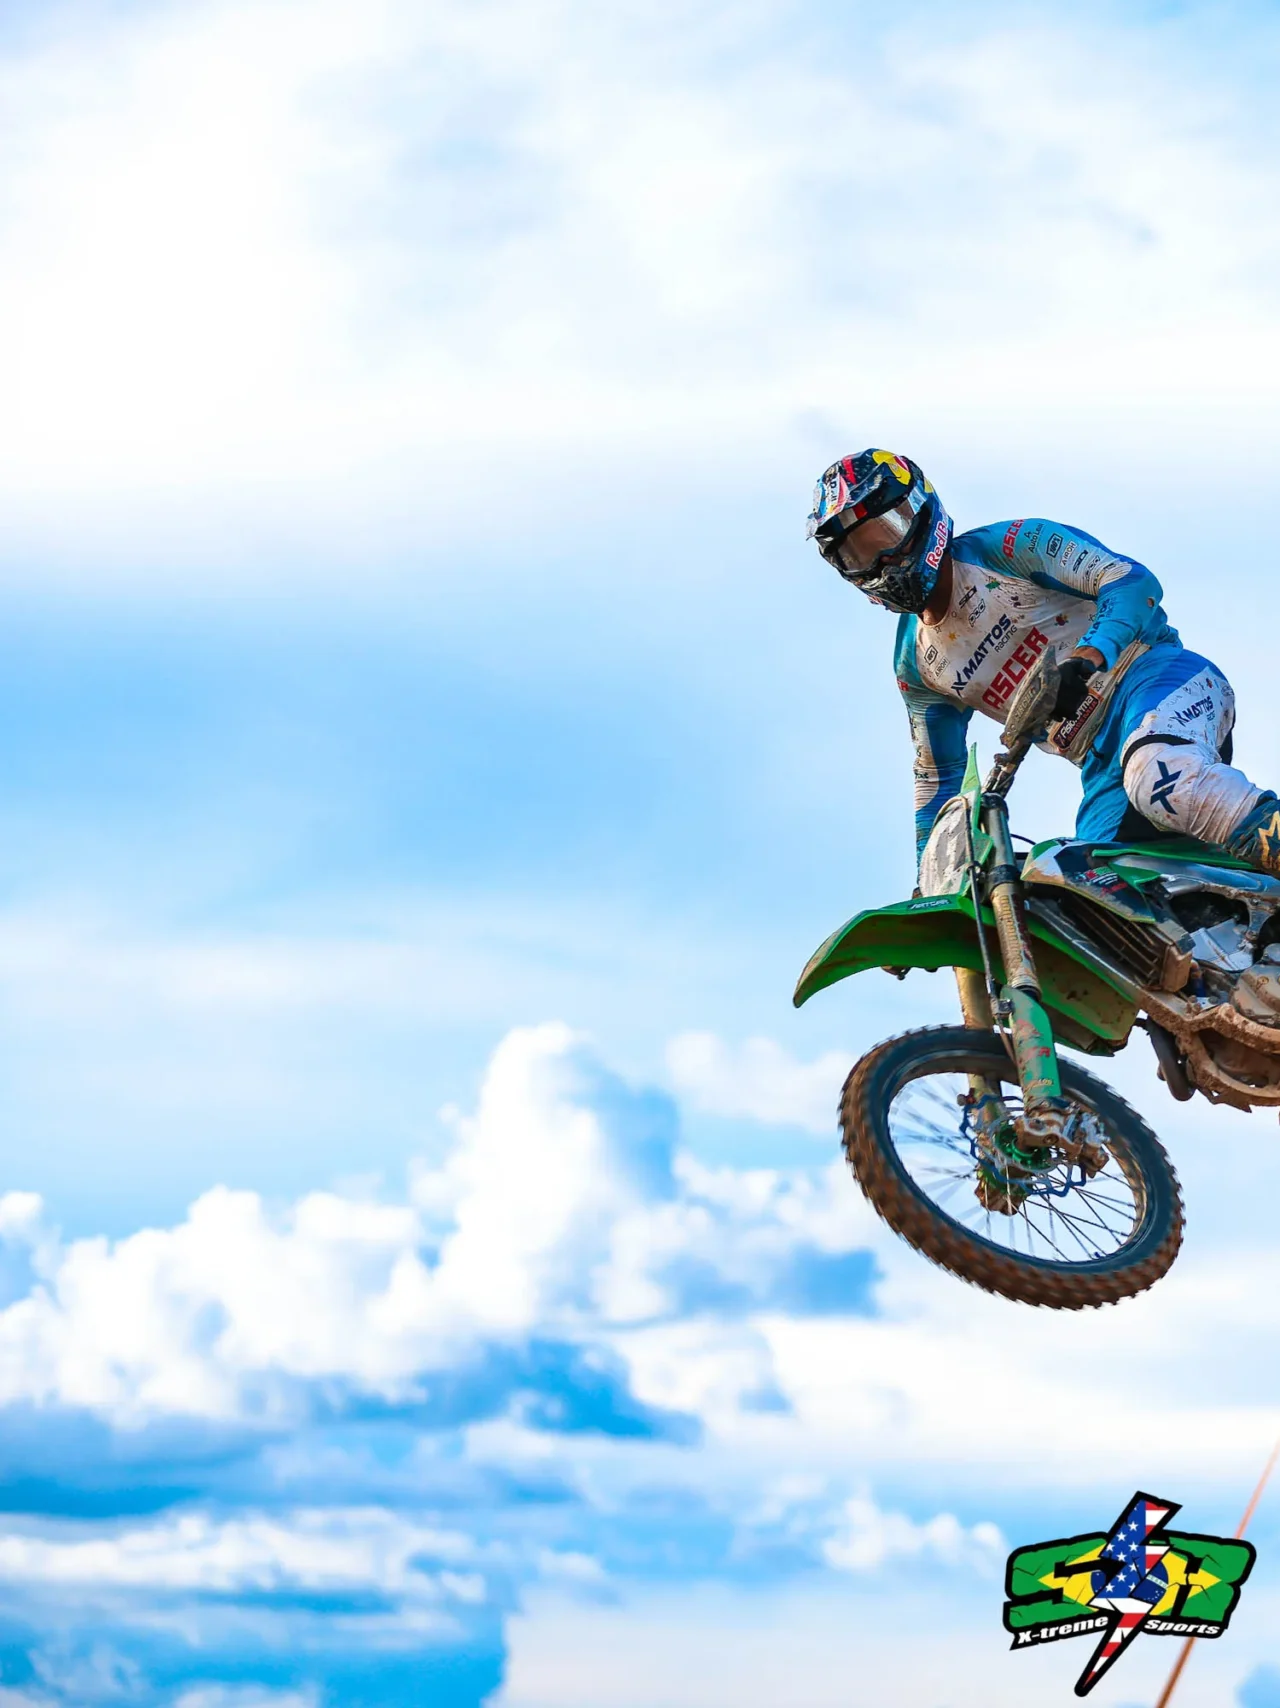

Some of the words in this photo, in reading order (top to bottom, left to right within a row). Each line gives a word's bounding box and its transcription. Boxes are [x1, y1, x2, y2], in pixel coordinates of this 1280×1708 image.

[926, 515, 948, 570] RedB
[1061, 542, 1077, 566] AIROH
[935, 659, 948, 677] AIROH
[982, 627, 1049, 710] ASCER
